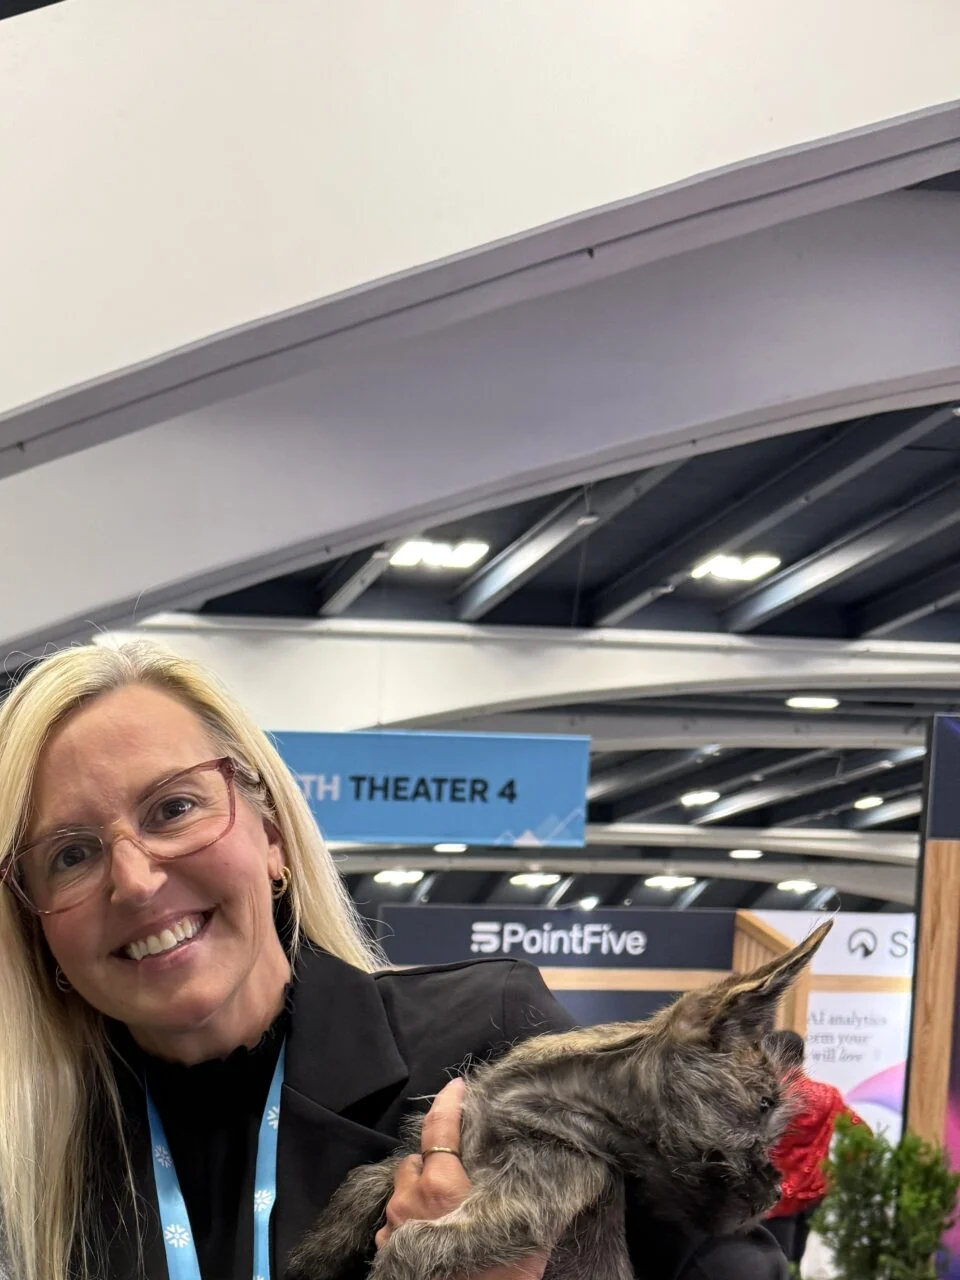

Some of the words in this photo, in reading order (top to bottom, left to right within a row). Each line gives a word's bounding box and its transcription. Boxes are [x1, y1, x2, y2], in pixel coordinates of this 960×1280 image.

[300, 774, 340, 801] TH
[349, 775, 489, 803] THEATER
[497, 778, 518, 803] 4
[502, 922, 648, 955] PointFive
[889, 931, 909, 958] S
[828, 1010, 888, 1030] analytics
